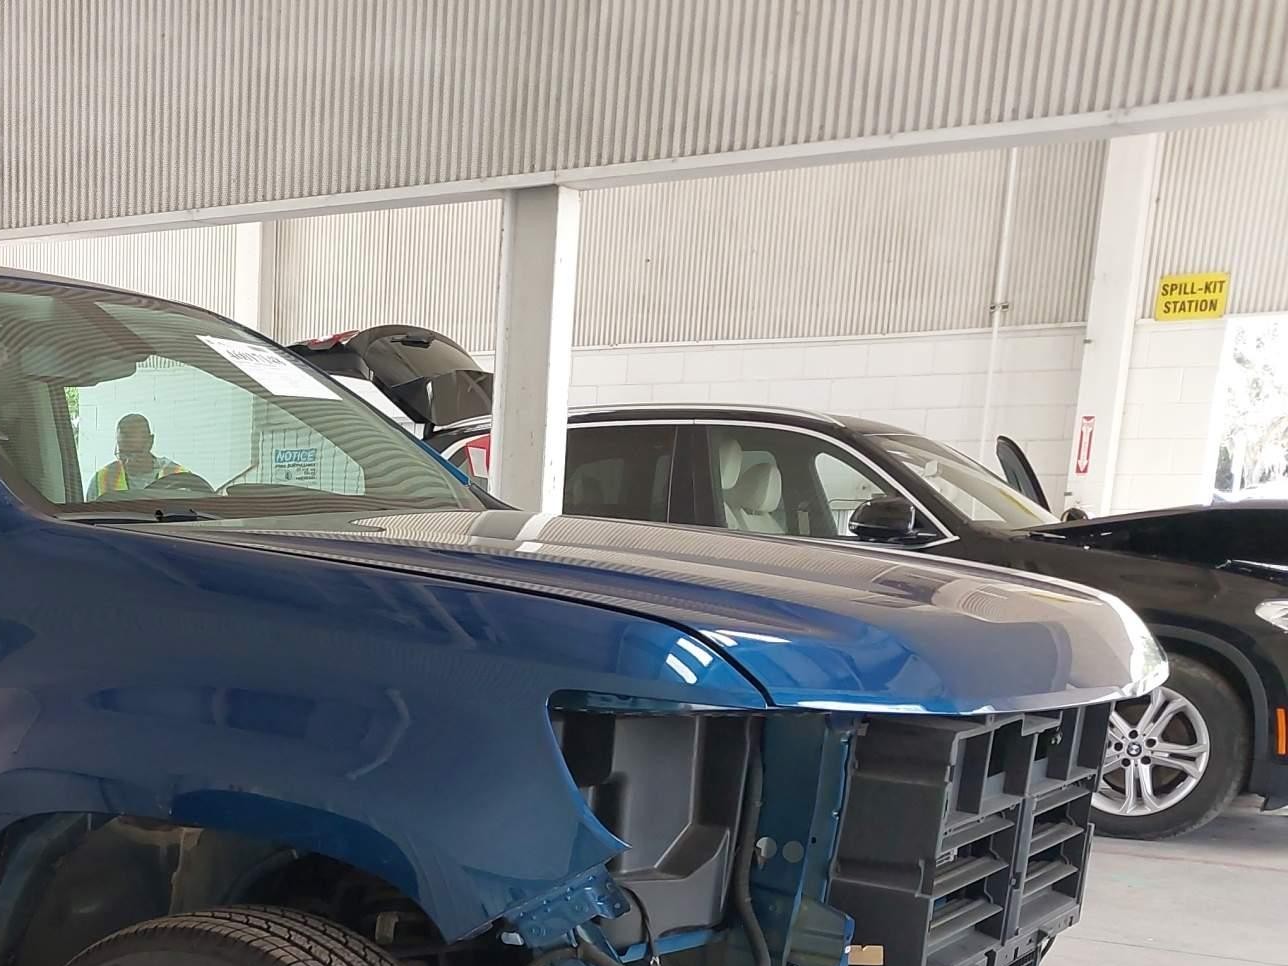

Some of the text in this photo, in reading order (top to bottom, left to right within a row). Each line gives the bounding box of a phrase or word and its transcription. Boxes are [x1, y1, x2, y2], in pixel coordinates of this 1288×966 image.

[1161, 280, 1225, 296] SPILL-KIT
[1163, 299, 1218, 313] STATION
[276, 450, 316, 462] NOTICE
